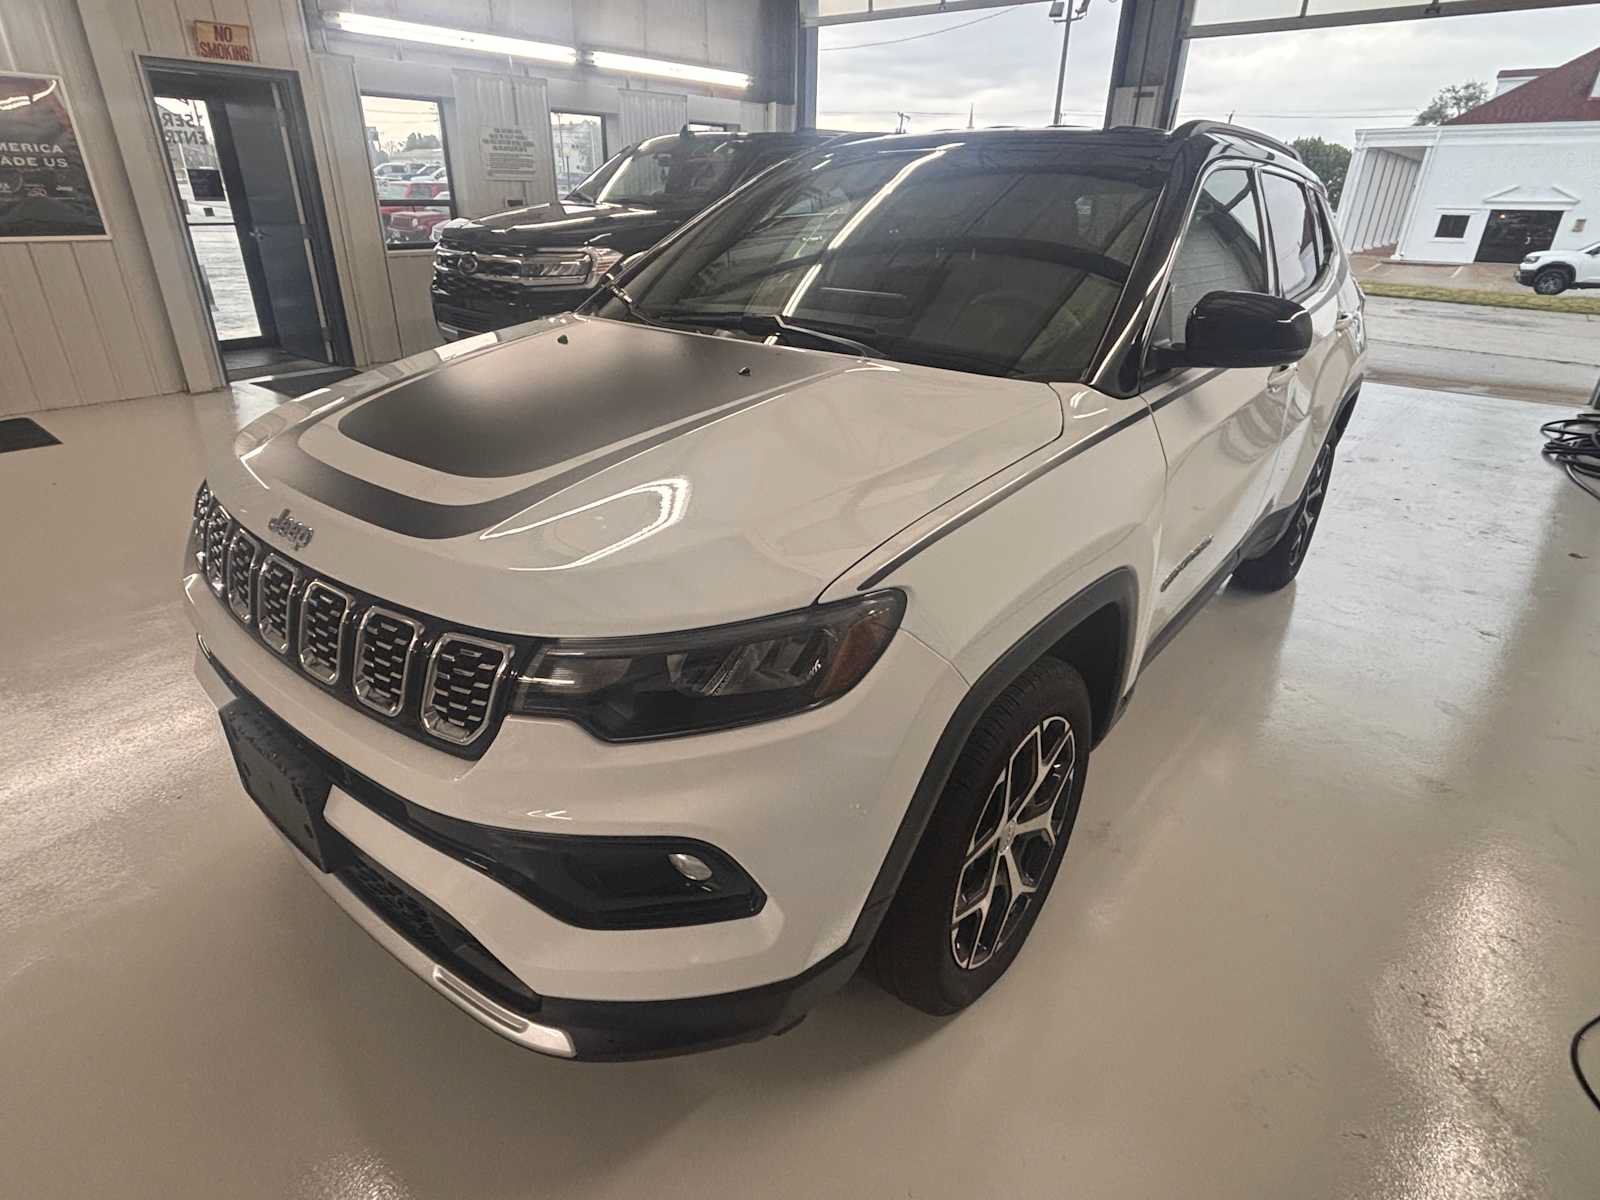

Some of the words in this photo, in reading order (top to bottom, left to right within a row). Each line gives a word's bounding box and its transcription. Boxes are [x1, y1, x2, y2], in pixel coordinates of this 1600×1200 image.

[213, 25, 233, 43] NO
[200, 41, 250, 61] SMOKING
[43, 157, 68, 168] US
[268, 508, 315, 552] Jeep
